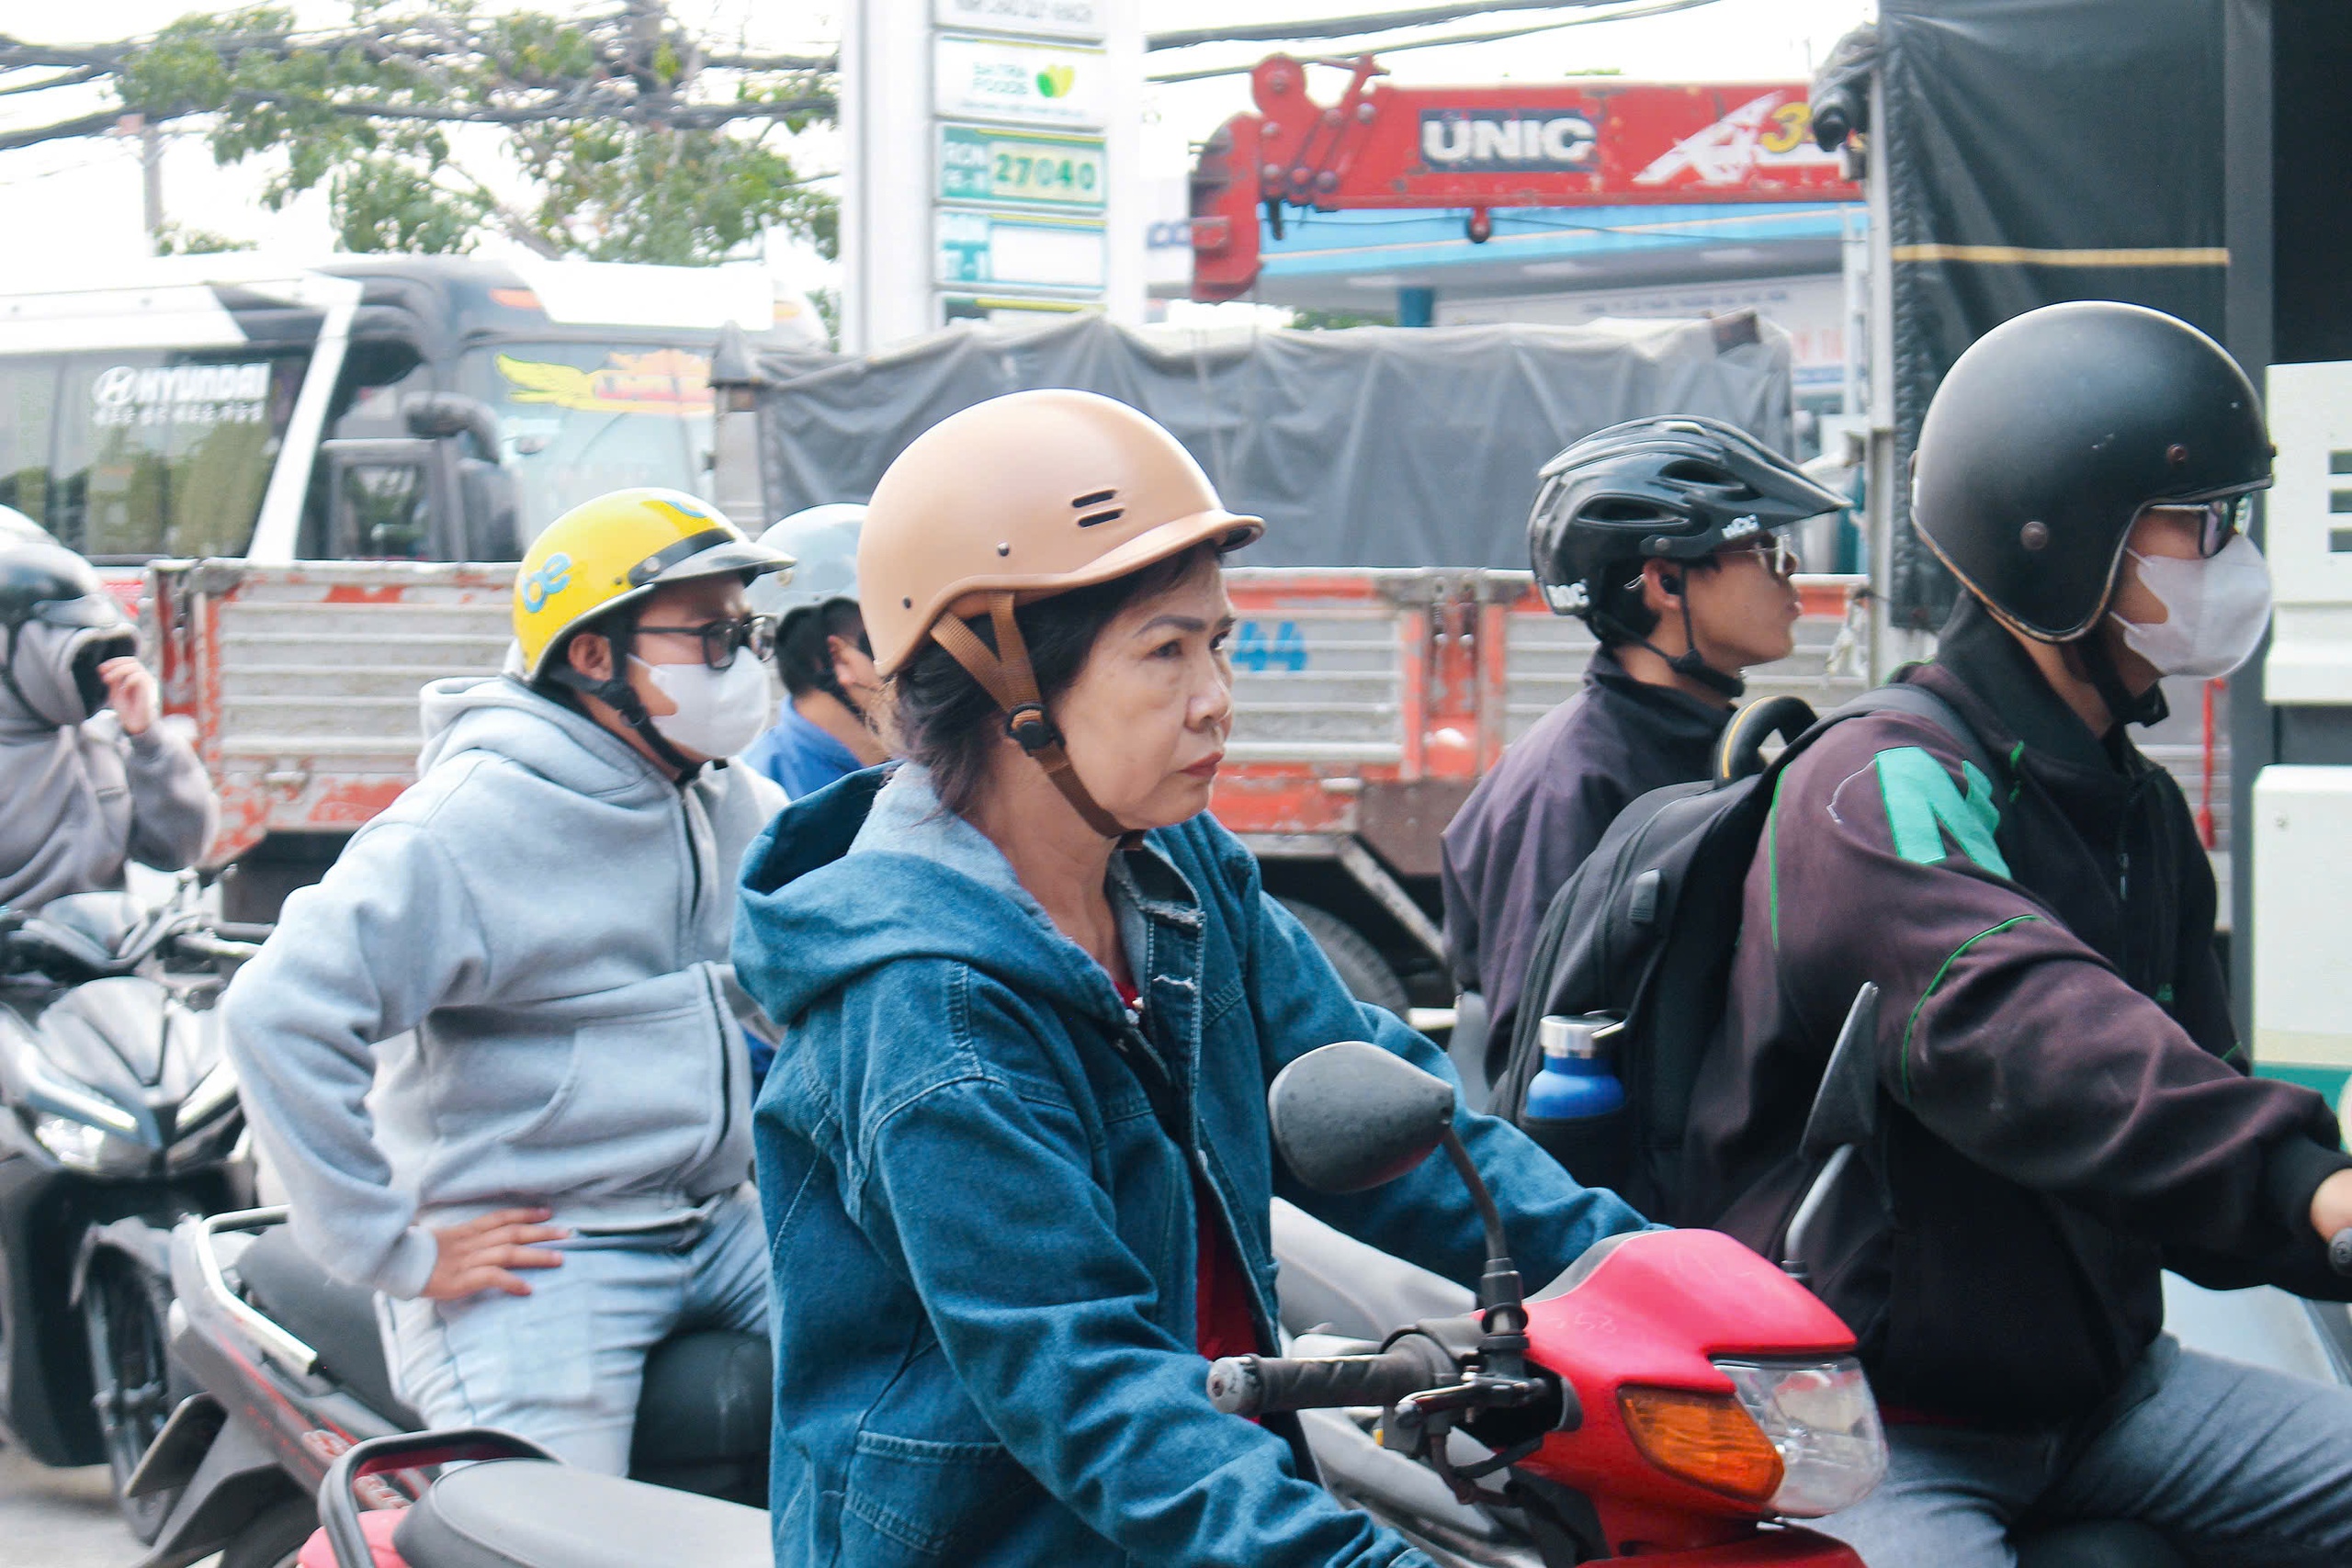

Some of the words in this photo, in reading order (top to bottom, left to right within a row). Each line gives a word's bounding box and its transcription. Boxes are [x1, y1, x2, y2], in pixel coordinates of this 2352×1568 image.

[1423, 117, 1597, 163] UNIC
[996, 152, 1096, 190] 27040
[135, 362, 269, 405] HYUNDAI
[519, 552, 572, 614] be
